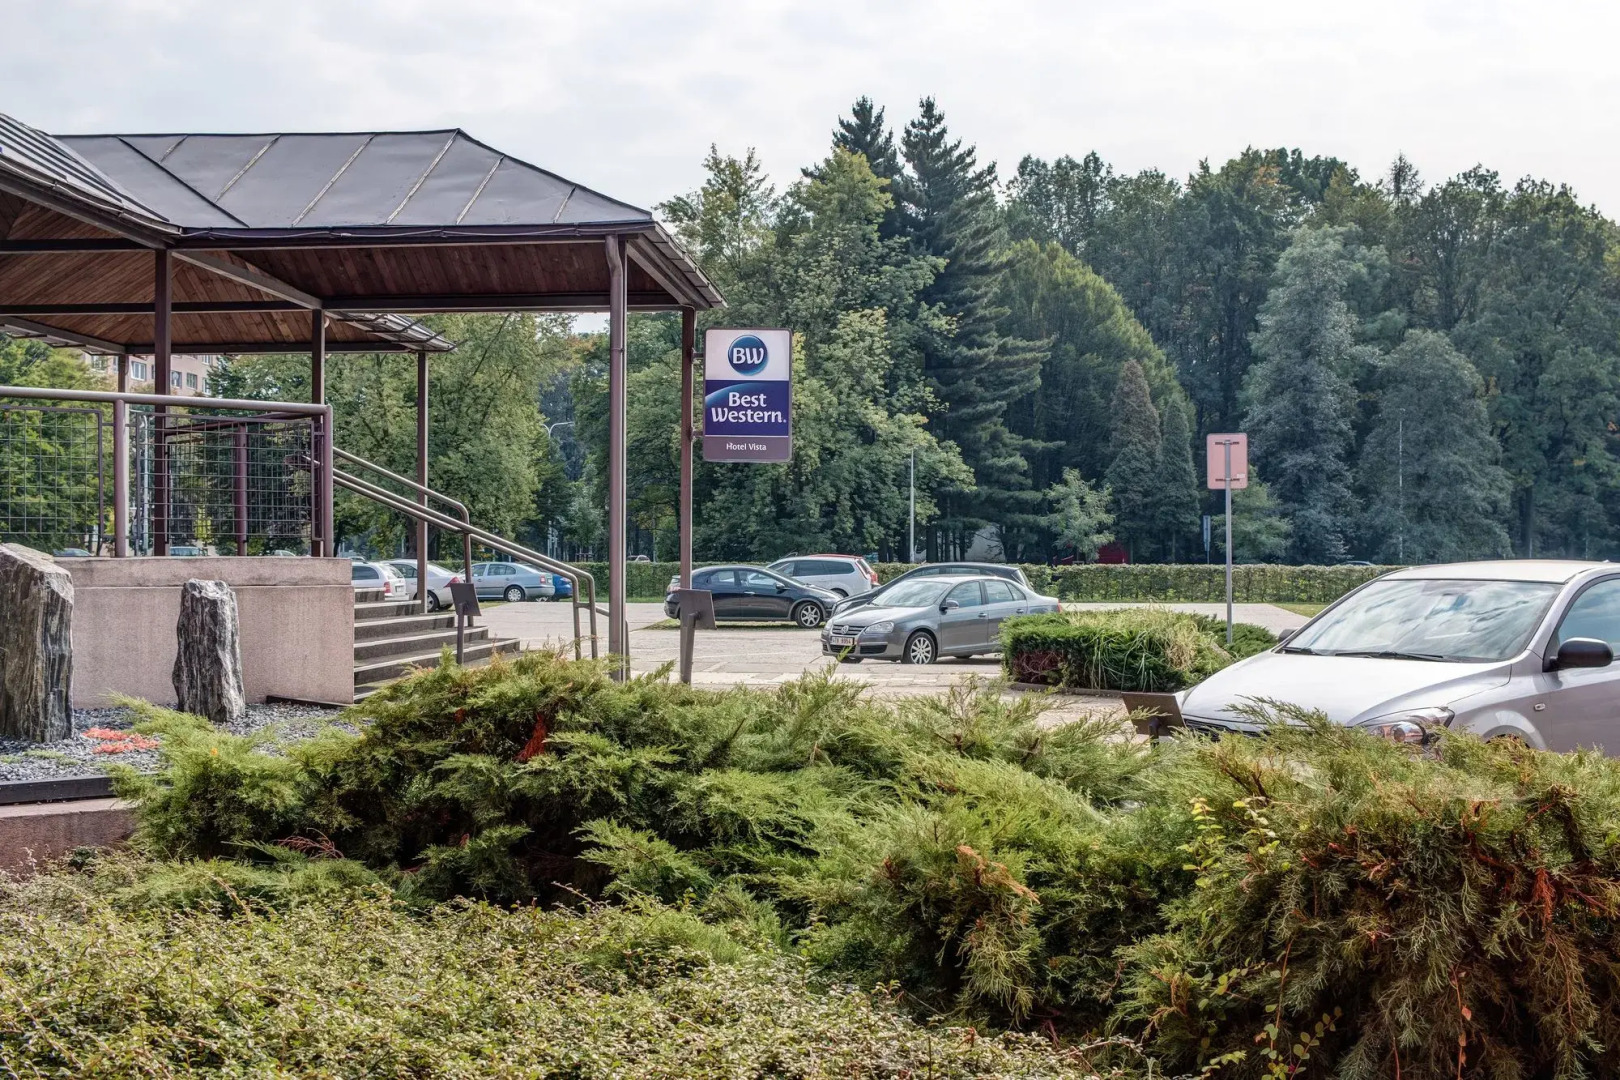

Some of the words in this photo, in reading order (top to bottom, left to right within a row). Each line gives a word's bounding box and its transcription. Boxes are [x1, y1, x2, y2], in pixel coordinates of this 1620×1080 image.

[733, 347, 764, 365] BW
[728, 392, 767, 407] Best
[726, 442, 747, 451] Hotel
[748, 442, 767, 451] Vista
